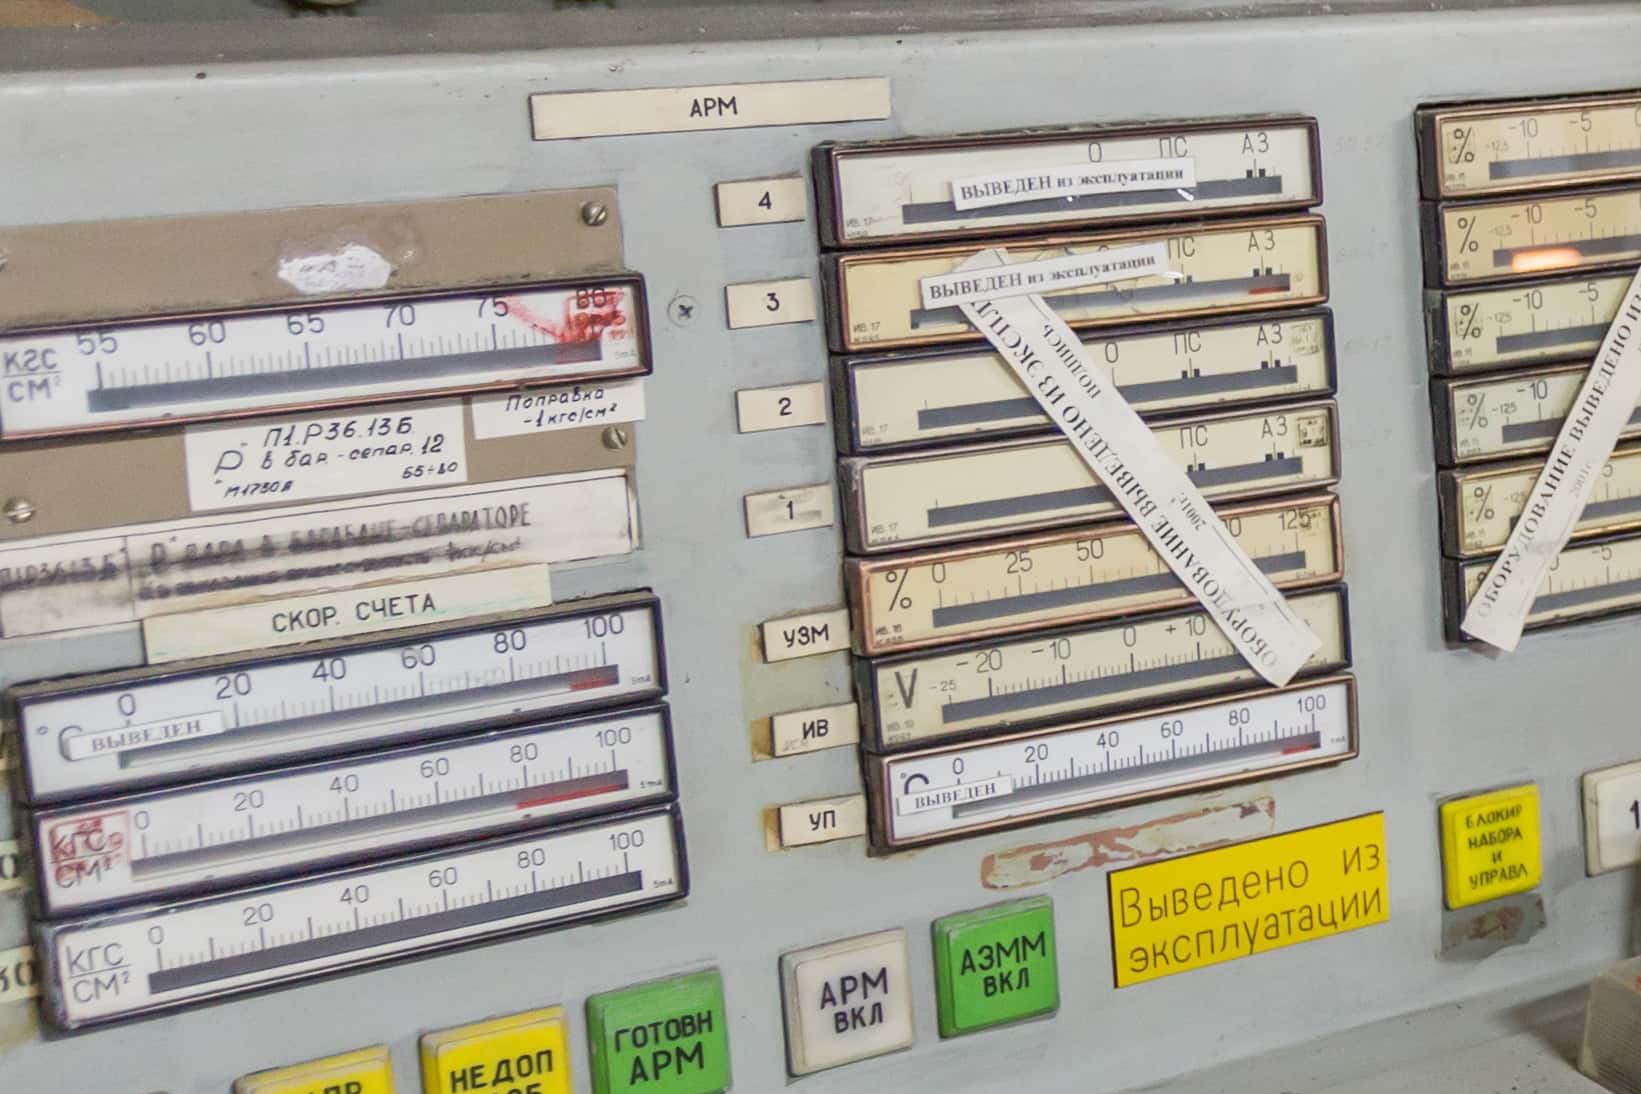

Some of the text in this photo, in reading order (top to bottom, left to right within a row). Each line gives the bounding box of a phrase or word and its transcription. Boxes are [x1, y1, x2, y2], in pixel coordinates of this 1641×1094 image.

[690, 97, 738, 117] АРМ
[1088, 132, 1270, 162] 0 ПС АЗ
[961, 168, 1184, 200] ВЫВЕДЕН из эксплуатации
[758, 191, 772, 210] 4
[1168, 230, 1276, 260] ПС АЗ
[929, 254, 1156, 301] ВЫВЕДЕН из эксплуатации
[766, 292, 780, 312] 3
[77, 296, 509, 355] 55 60 65 70 75
[1104, 323, 1283, 363] 0 ПС АЗ
[506, 388, 605, 411] Поправка
[1038, 375, 1065, 405] ИЗ
[1570, 330, 1635, 442] ВЫВЕДЕНО
[778, 396, 793, 417] 2
[422, 433, 444, 454] 12
[1180, 415, 1287, 448] ПС АЗ
[785, 501, 794, 521] 1
[886, 538, 1104, 612] % 0 25 50
[272, 593, 437, 634] СКОР. СЧЕТА
[783, 624, 829, 646] УЗМ
[1123, 625, 1136, 647] 0
[117, 612, 624, 717] 0 20 40 60 80 100
[895, 668, 918, 709] V
[90, 718, 202, 753] ВЫВЕДЕН
[801, 718, 829, 740] ИВ
[952, 694, 1327, 775] 0 20 40 60 80 100
[133, 726, 631, 833] 0 20 40 60 80 100
[914, 782, 998, 811] ВЫВЕДЕН
[809, 808, 837, 830] УП
[1464, 802, 1524, 832] БЛОКИР
[1628, 800, 1641, 831] 1
[1468, 825, 1524, 854] НАБОРА
[1468, 860, 1530, 888] УПРАВЛ
[1491, 850, 1503, 866] И
[148, 829, 645, 945] 0 20 40 60 80 100
[1119, 843, 1381, 930] Выведено из
[1128, 887, 1384, 975] эксплуатации
[958, 930, 1047, 975] АЗММ
[818, 967, 889, 1006] АРМ
[984, 964, 1031, 999] ВКЛ
[828, 1002, 882, 1030] ВКЛ
[614, 1011, 714, 1054] ГОТОВН
[449, 1048, 555, 1094] НЕДОП
[628, 1042, 706, 1087] АРМ
